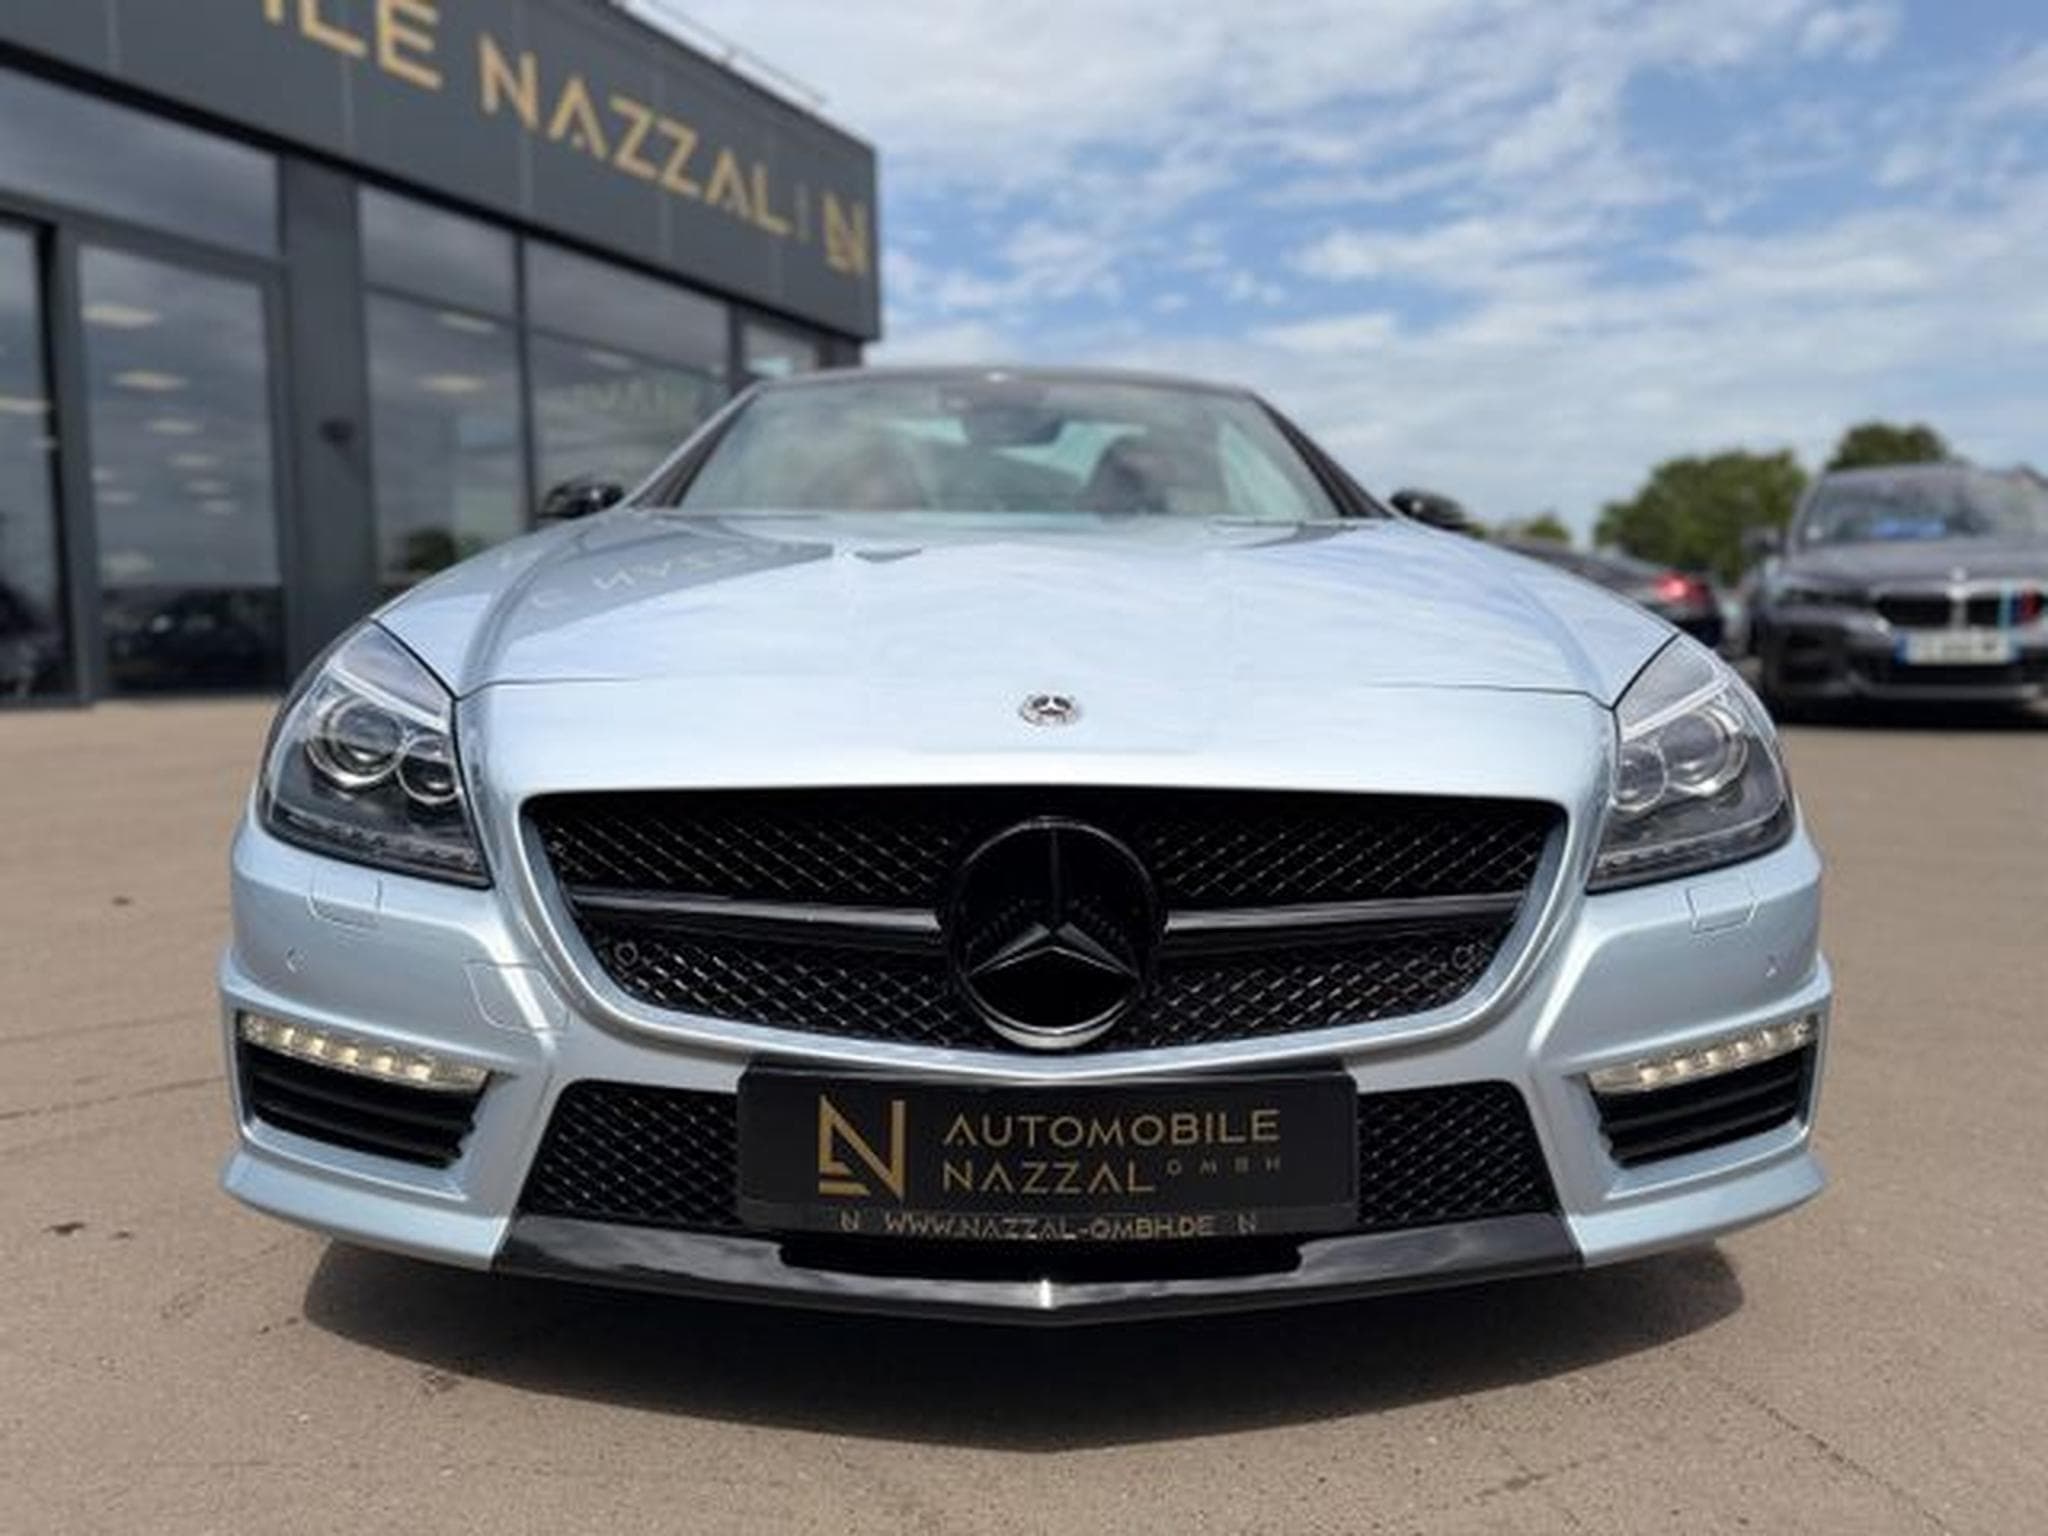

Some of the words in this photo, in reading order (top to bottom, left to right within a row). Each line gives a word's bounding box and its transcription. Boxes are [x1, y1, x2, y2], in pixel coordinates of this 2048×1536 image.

[477, 32, 793, 237] NAZZAL
[943, 1109, 1281, 1148] AUTOMOBILE
[943, 1160, 1155, 1195] NAZZAL
